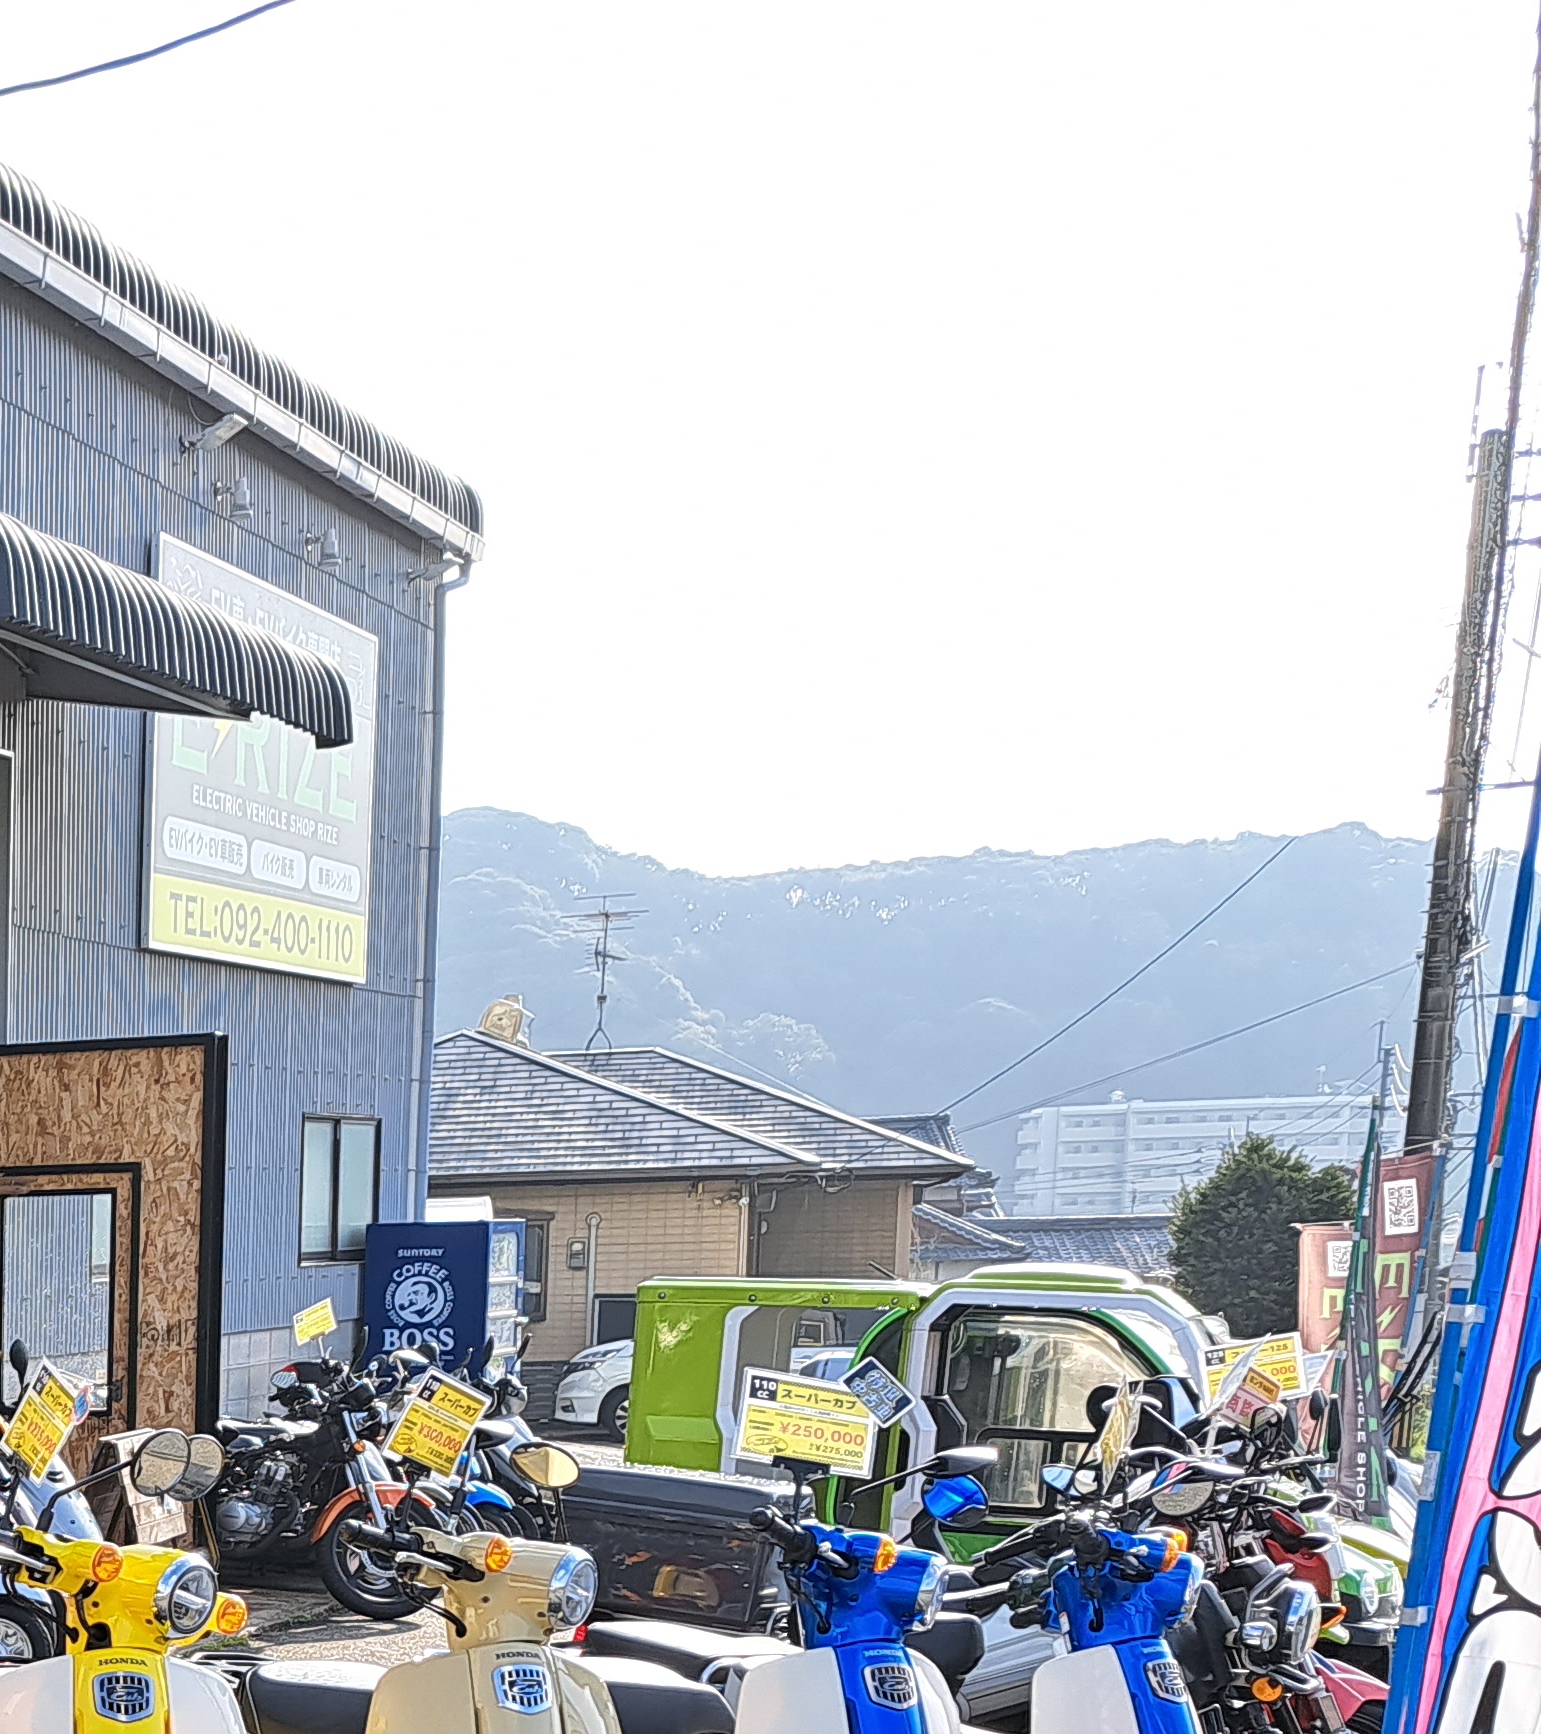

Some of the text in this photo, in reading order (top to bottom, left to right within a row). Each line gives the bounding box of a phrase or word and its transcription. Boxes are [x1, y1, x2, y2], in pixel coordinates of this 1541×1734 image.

[191, 784, 339, 846] ELECTRIC VEHICLE SHOP RIZE
[261, 850, 296, 880] バイク販売
[397, 1248, 445, 1258] SUNTORY
[392, 1261, 449, 1282] COFFEE
[381, 1327, 455, 1351] BOSS
[753, 1378, 777, 1391] 110
[781, 1387, 857, 1410] スーパーカブ
[778, 1420, 865, 1447] ¥250,000
[97, 1657, 149, 1667] HONDA
[494, 1650, 542, 1661] HONDA
